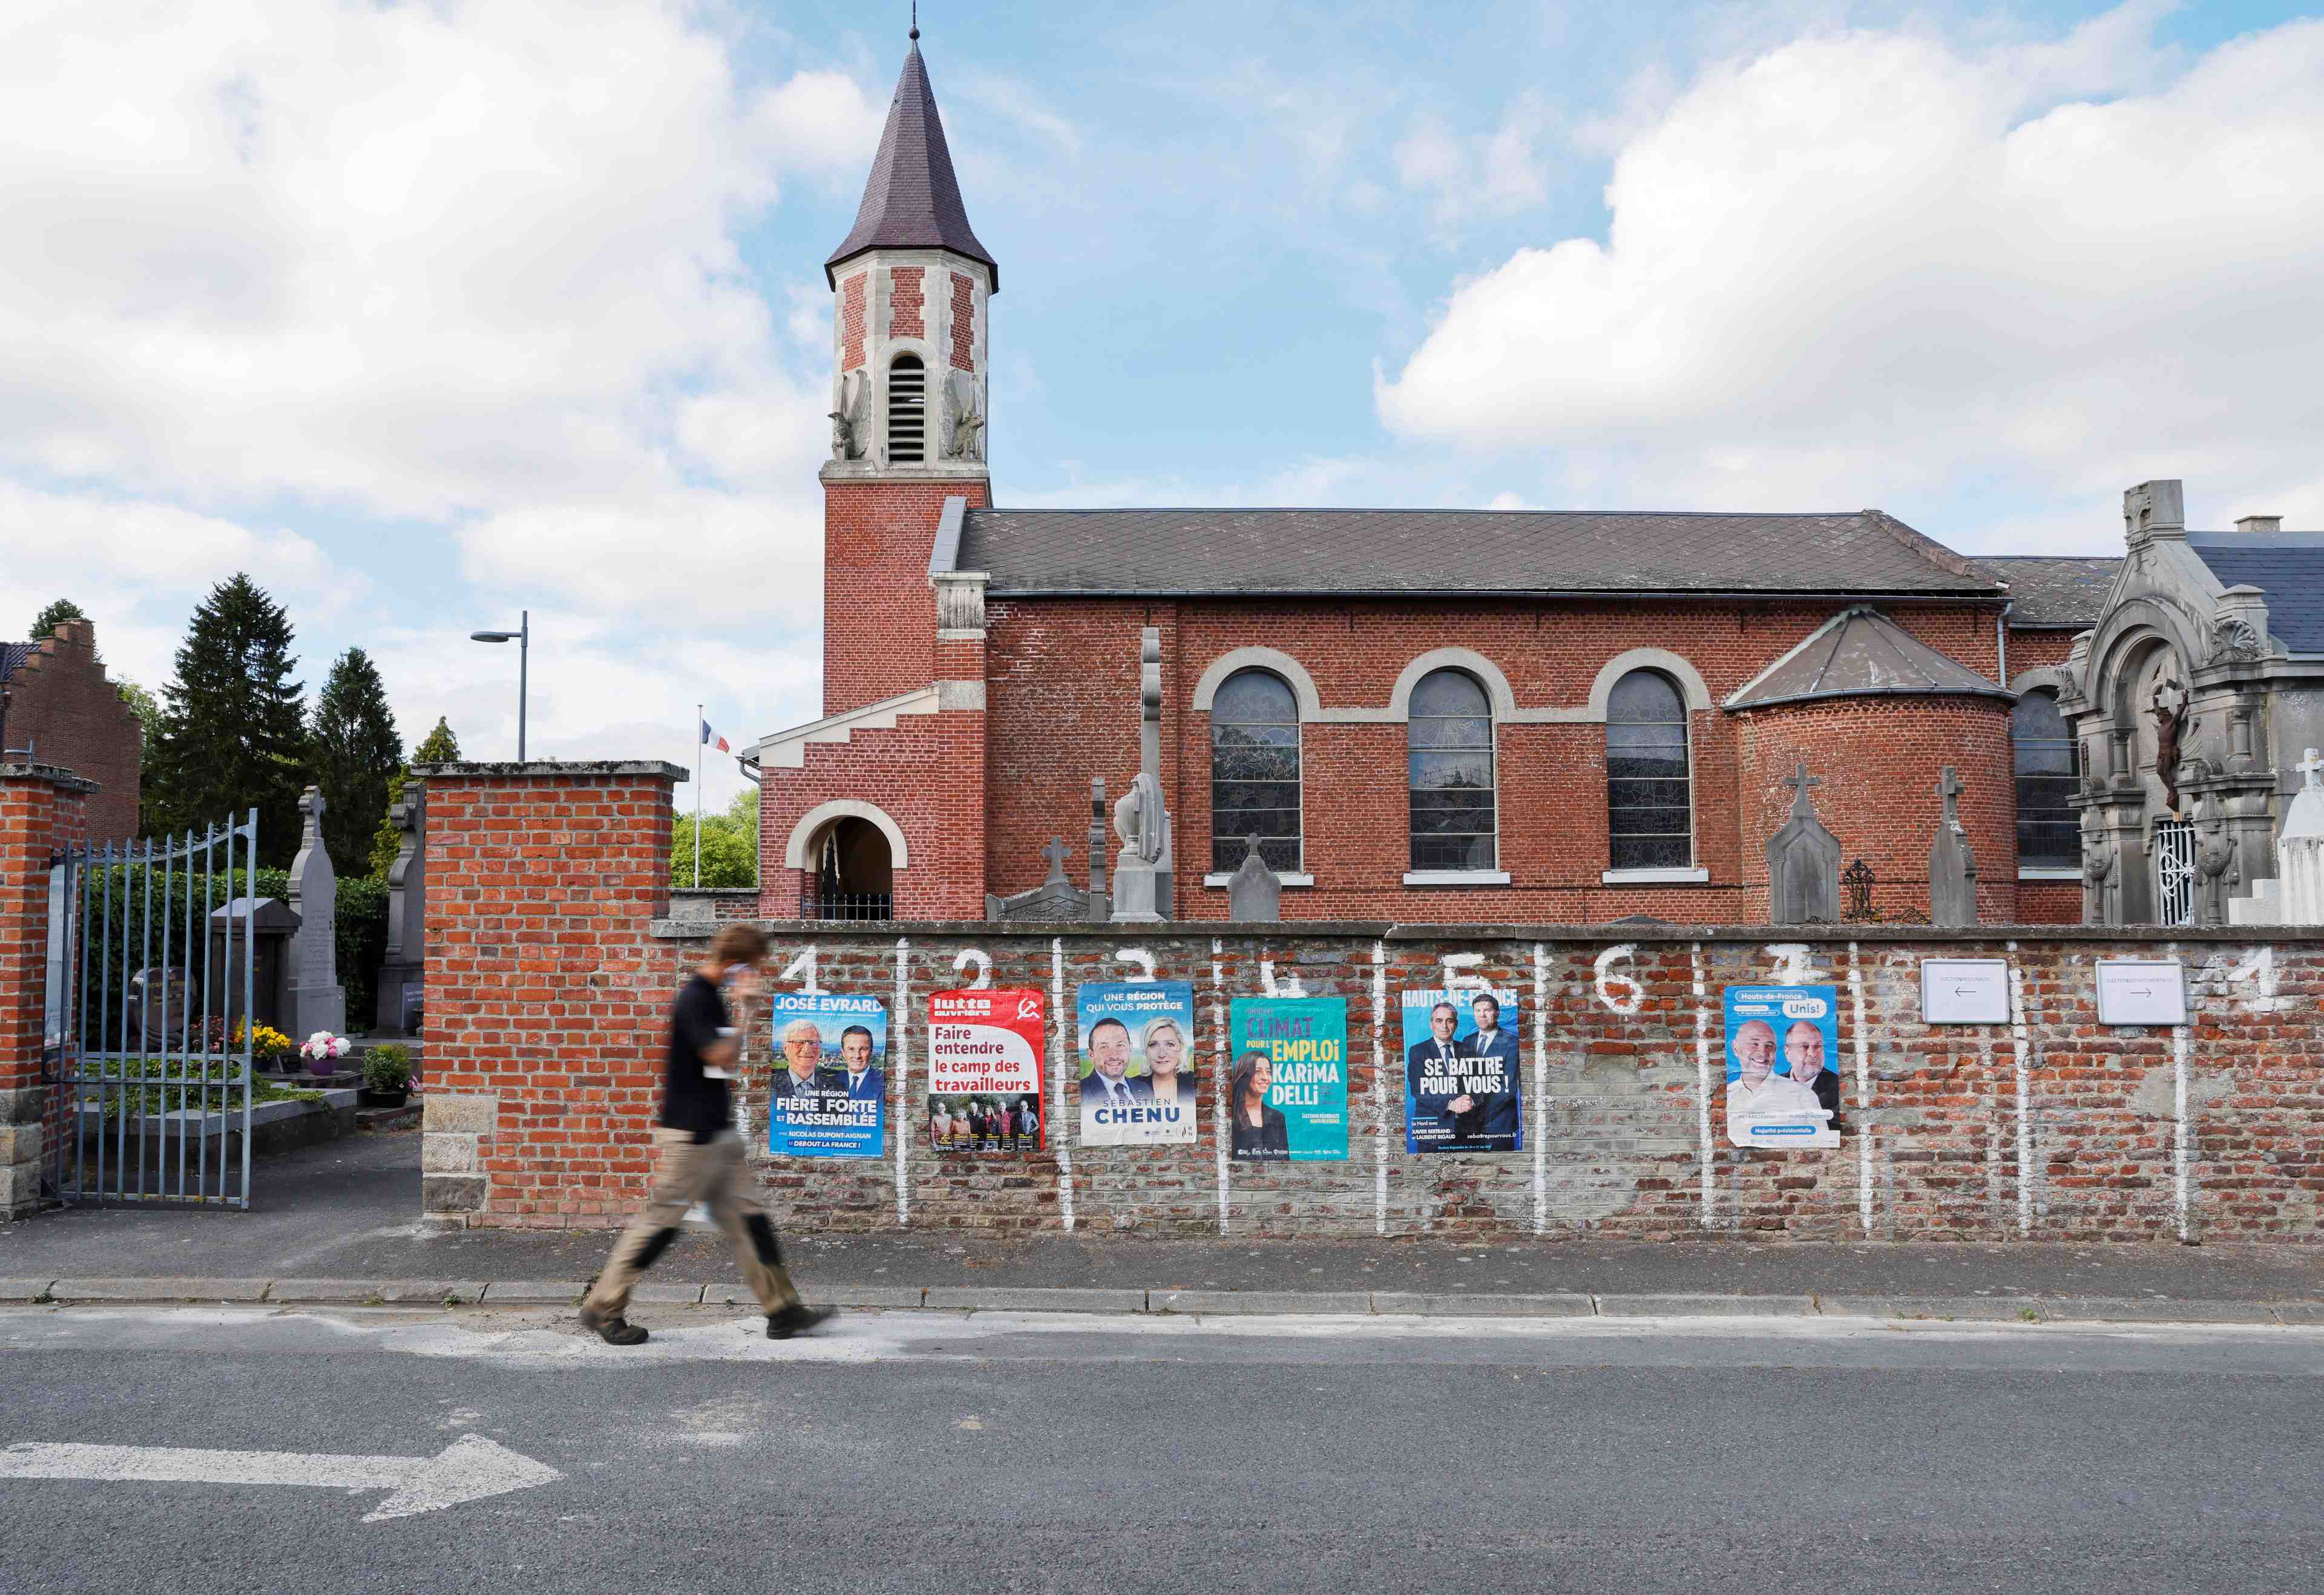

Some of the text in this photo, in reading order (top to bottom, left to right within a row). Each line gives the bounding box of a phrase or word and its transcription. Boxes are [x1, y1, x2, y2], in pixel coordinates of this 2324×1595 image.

[1594, 943, 1644, 1015] 6
[776, 995, 883, 1012] JOSÉ EVRARD
[934, 998, 991, 1009] lutte
[1104, 991, 1165, 1001] UNE RÉGION
[1086, 1003, 1105, 1013] QUI
[1137, 1001, 1183, 1010] PROTÈGE
[1790, 1003, 1819, 1014] Unis!
[935, 1025, 971, 1039] Faire
[935, 1041, 1004, 1054] entendre
[935, 1060, 1020, 1075] le camp des
[1424, 1056, 1503, 1076] SE BATTRE
[935, 1077, 1030, 1092] travailleurs
[1420, 1075, 1509, 1094] POUR VOUS !
[776, 1095, 877, 1113] FIÈRE FORTE
[787, 1113, 877, 1127] RASSEMBLÉE
[1095, 1107, 1180, 1124] CHENU
